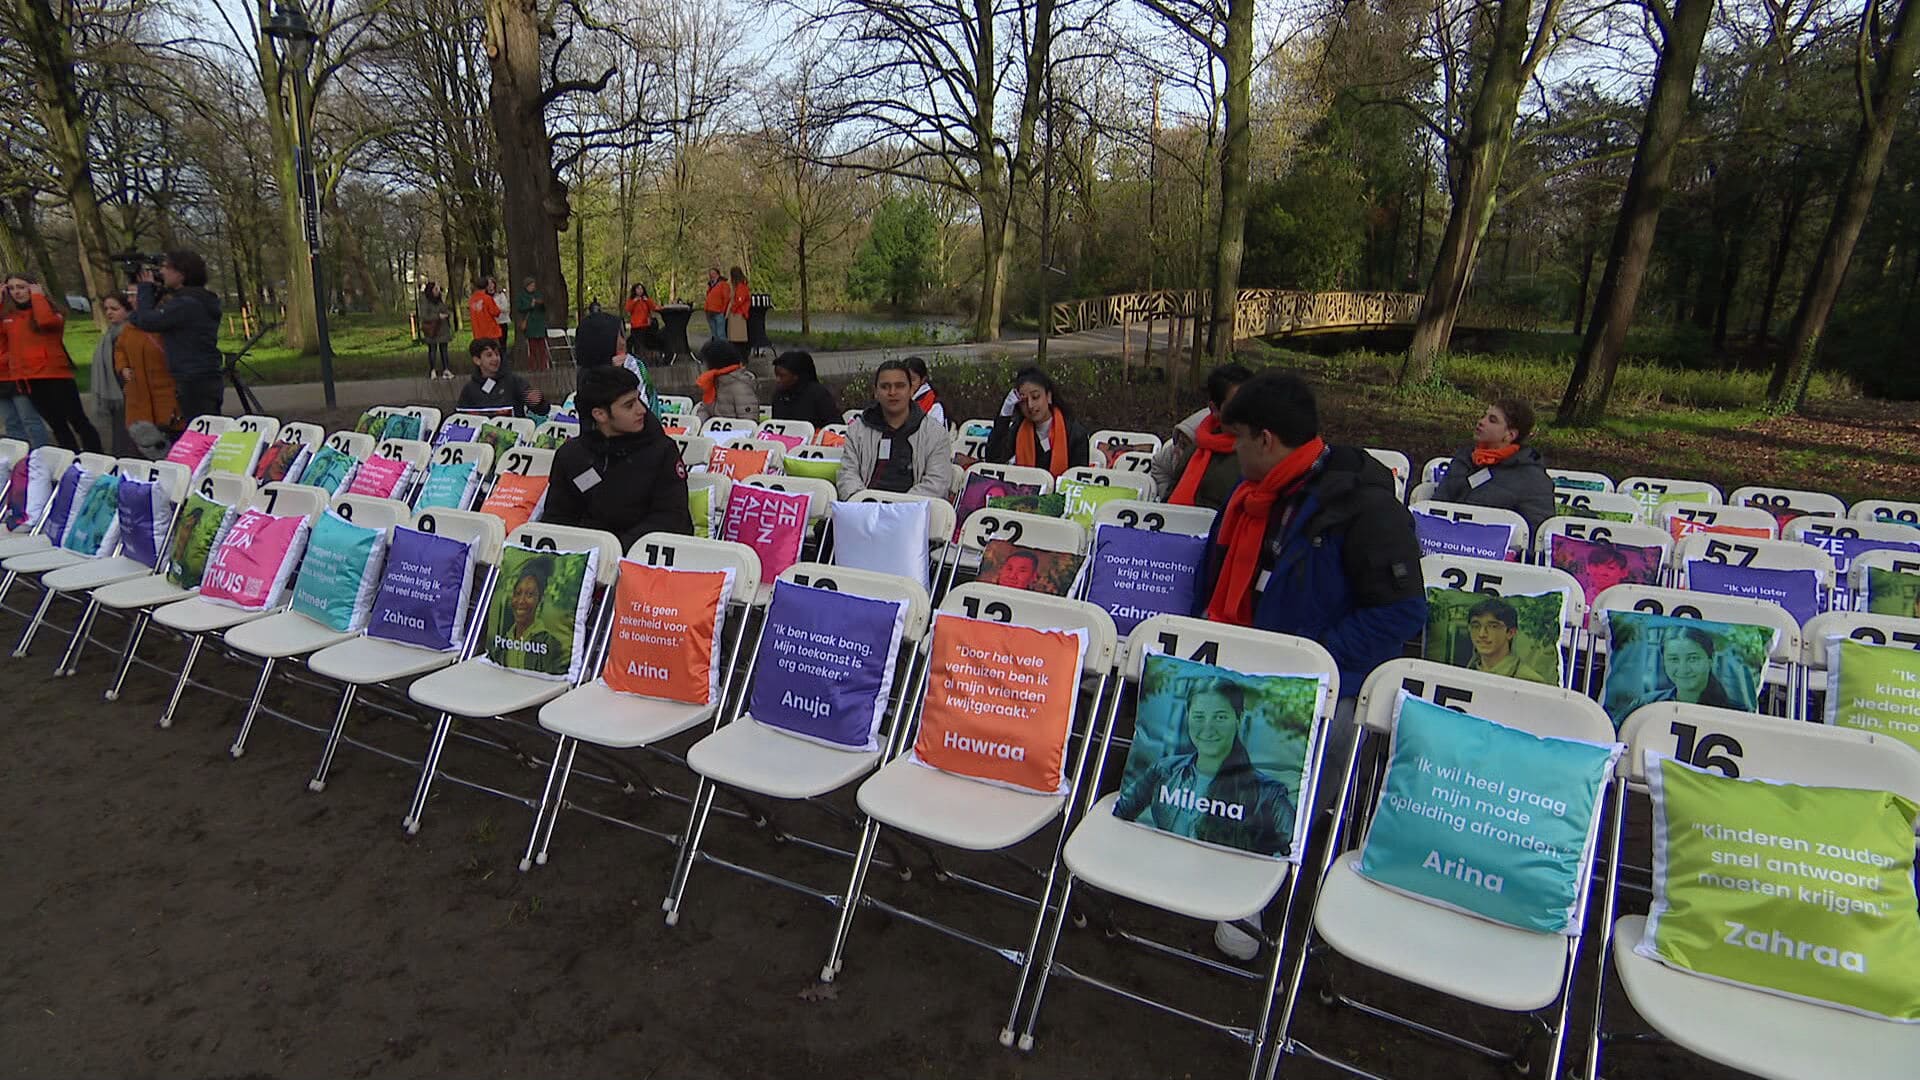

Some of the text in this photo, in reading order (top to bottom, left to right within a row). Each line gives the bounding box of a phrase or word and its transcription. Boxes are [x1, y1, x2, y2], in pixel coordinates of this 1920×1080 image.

[331, 436, 350, 456] 24
[382, 442, 403, 462] 25
[440, 448, 464, 464] 26
[713, 450, 728, 462] ZE
[508, 454, 533, 476] 27
[202, 477, 214, 498] 6
[264, 490, 278, 514] 7
[744, 496, 760, 522] AL
[778, 500, 799, 526] ZE
[726, 495, 748, 542] THUI
[757, 498, 780, 544] ZIJN
[976, 516, 1024, 547] 32
[1443, 542, 1460, 551] zou
[1461, 544, 1475, 554] het
[1477, 548, 1497, 558] voor
[1703, 539, 1759, 568] 57
[420, 564, 432, 576] het
[1117, 566, 1174, 583] krijg ik heel
[1131, 555, 1148, 567] het
[1150, 558, 1194, 574] wachten
[206, 568, 244, 593] THUIS
[395, 586, 410, 596] veel
[416, 576, 431, 590] krijg
[432, 580, 440, 590] ik
[1114, 579, 1134, 590] veel
[1741, 585, 1758, 594] wil
[1760, 587, 1787, 598] later
[382, 609, 425, 630] Zahraa
[642, 604, 650, 614] is
[652, 606, 678, 618] geen
[1110, 603, 1170, 620] Zahra
[619, 614, 688, 634] zekerheid voor
[619, 629, 630, 640] de
[494, 636, 548, 656] Precious
[787, 625, 807, 640] ben
[808, 630, 836, 646] vaak
[838, 635, 872, 657] bang.
[774, 638, 863, 669] Mijn toekomst is
[993, 650, 1014, 664] het
[1016, 654, 1044, 668] vele
[627, 660, 669, 681] Arina
[778, 658, 796, 674] erg
[944, 661, 1049, 686] verhuizen ben ik
[780, 689, 832, 718] Anuja
[956, 680, 986, 698] mijn
[988, 684, 1046, 704] vrienden
[944, 730, 1026, 762] Hawraa
[1670, 721, 1744, 778] 16
[1436, 761, 1460, 781] wil
[1464, 770, 1504, 796] heel
[1508, 784, 1568, 818] graag
[1158, 784, 1245, 822] Milena
[1388, 794, 1467, 834] opleiding
[1432, 784, 1531, 826] mijn mode
[1816, 838, 1896, 870] zouden
[1422, 848, 1504, 894] Arina
[1711, 846, 1881, 892] snel antwoord
[1697, 870, 1796, 899] moeten
[1722, 920, 1868, 975] Zahraa
